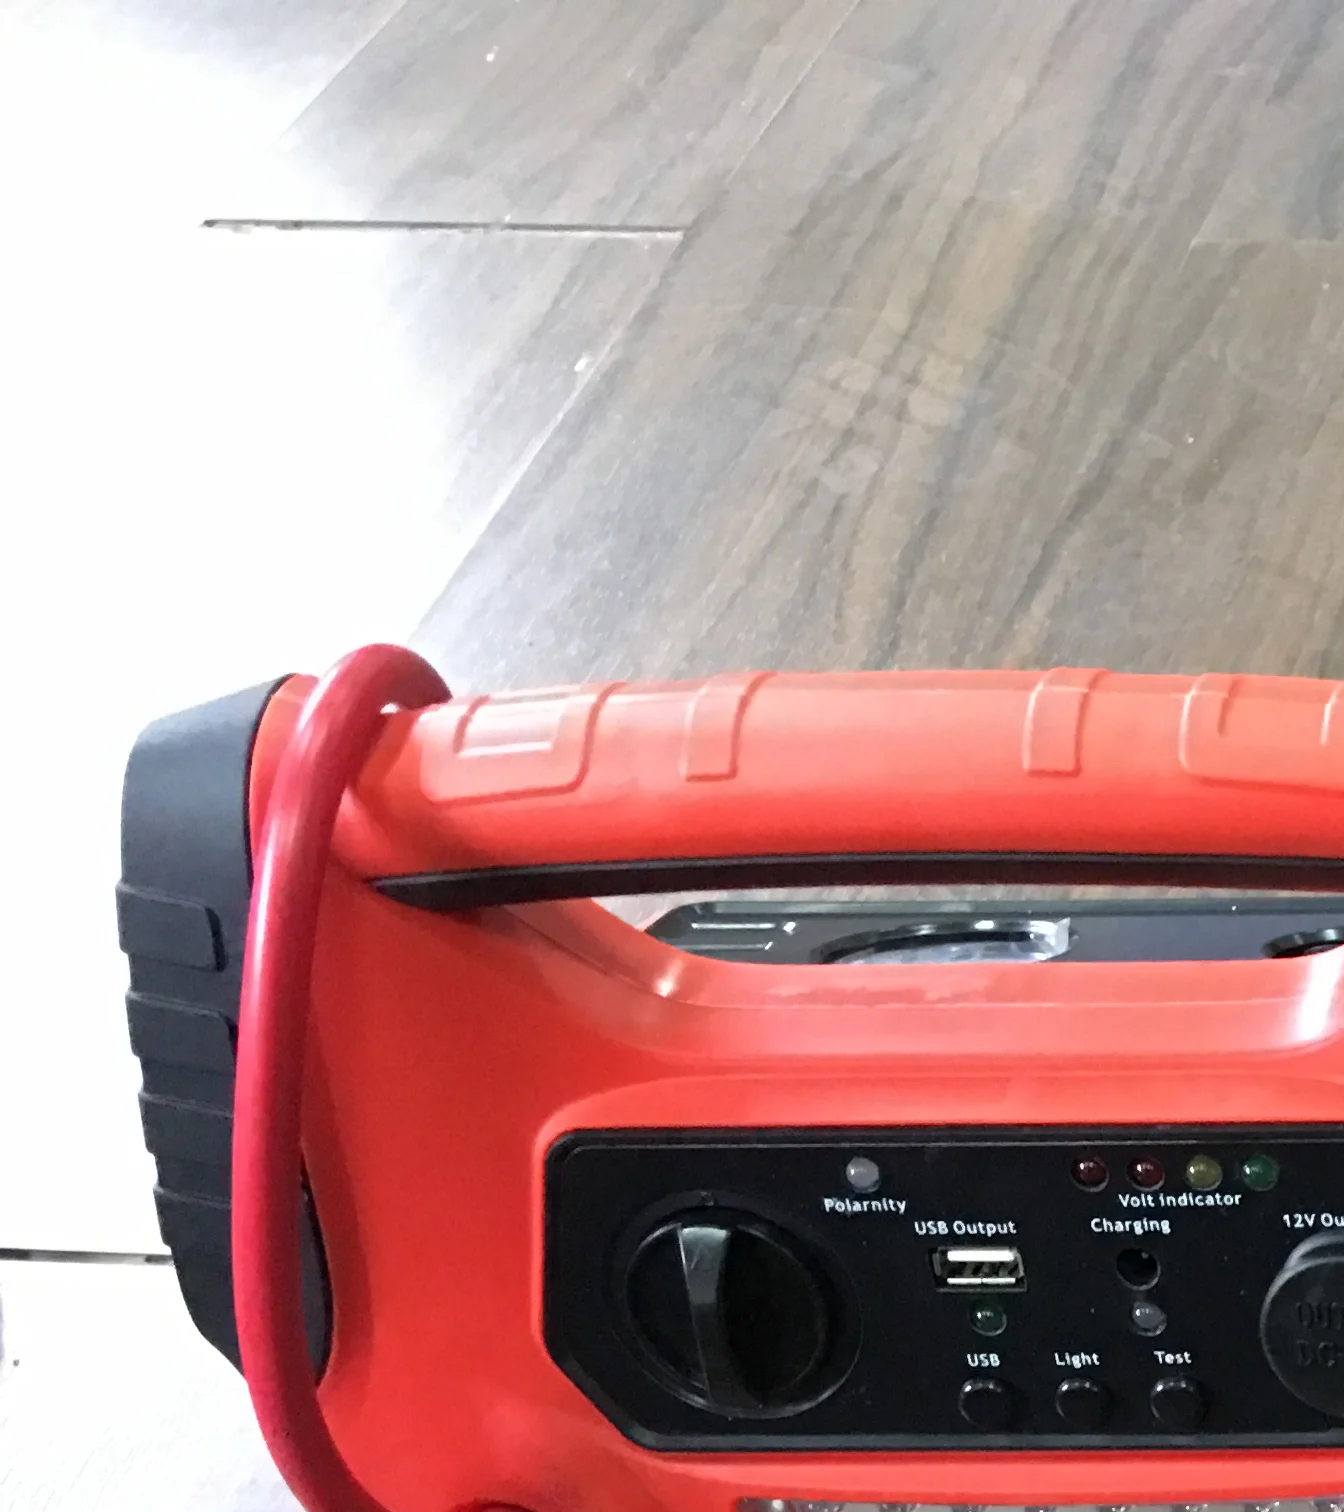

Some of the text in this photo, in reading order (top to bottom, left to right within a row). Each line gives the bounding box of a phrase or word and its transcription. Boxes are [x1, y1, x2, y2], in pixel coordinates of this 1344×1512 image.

[823, 1197, 907, 1215] Polarnity
[1118, 1193, 1155, 1208] Volt
[1091, 1217, 1171, 1235] Charging
[1282, 1213, 1315, 1228] 12V
[914, 1220, 1017, 1238] USB Output
[967, 1353, 1001, 1368] USB
[1053, 1351, 1101, 1369] Light
[1153, 1350, 1193, 1365] Test
